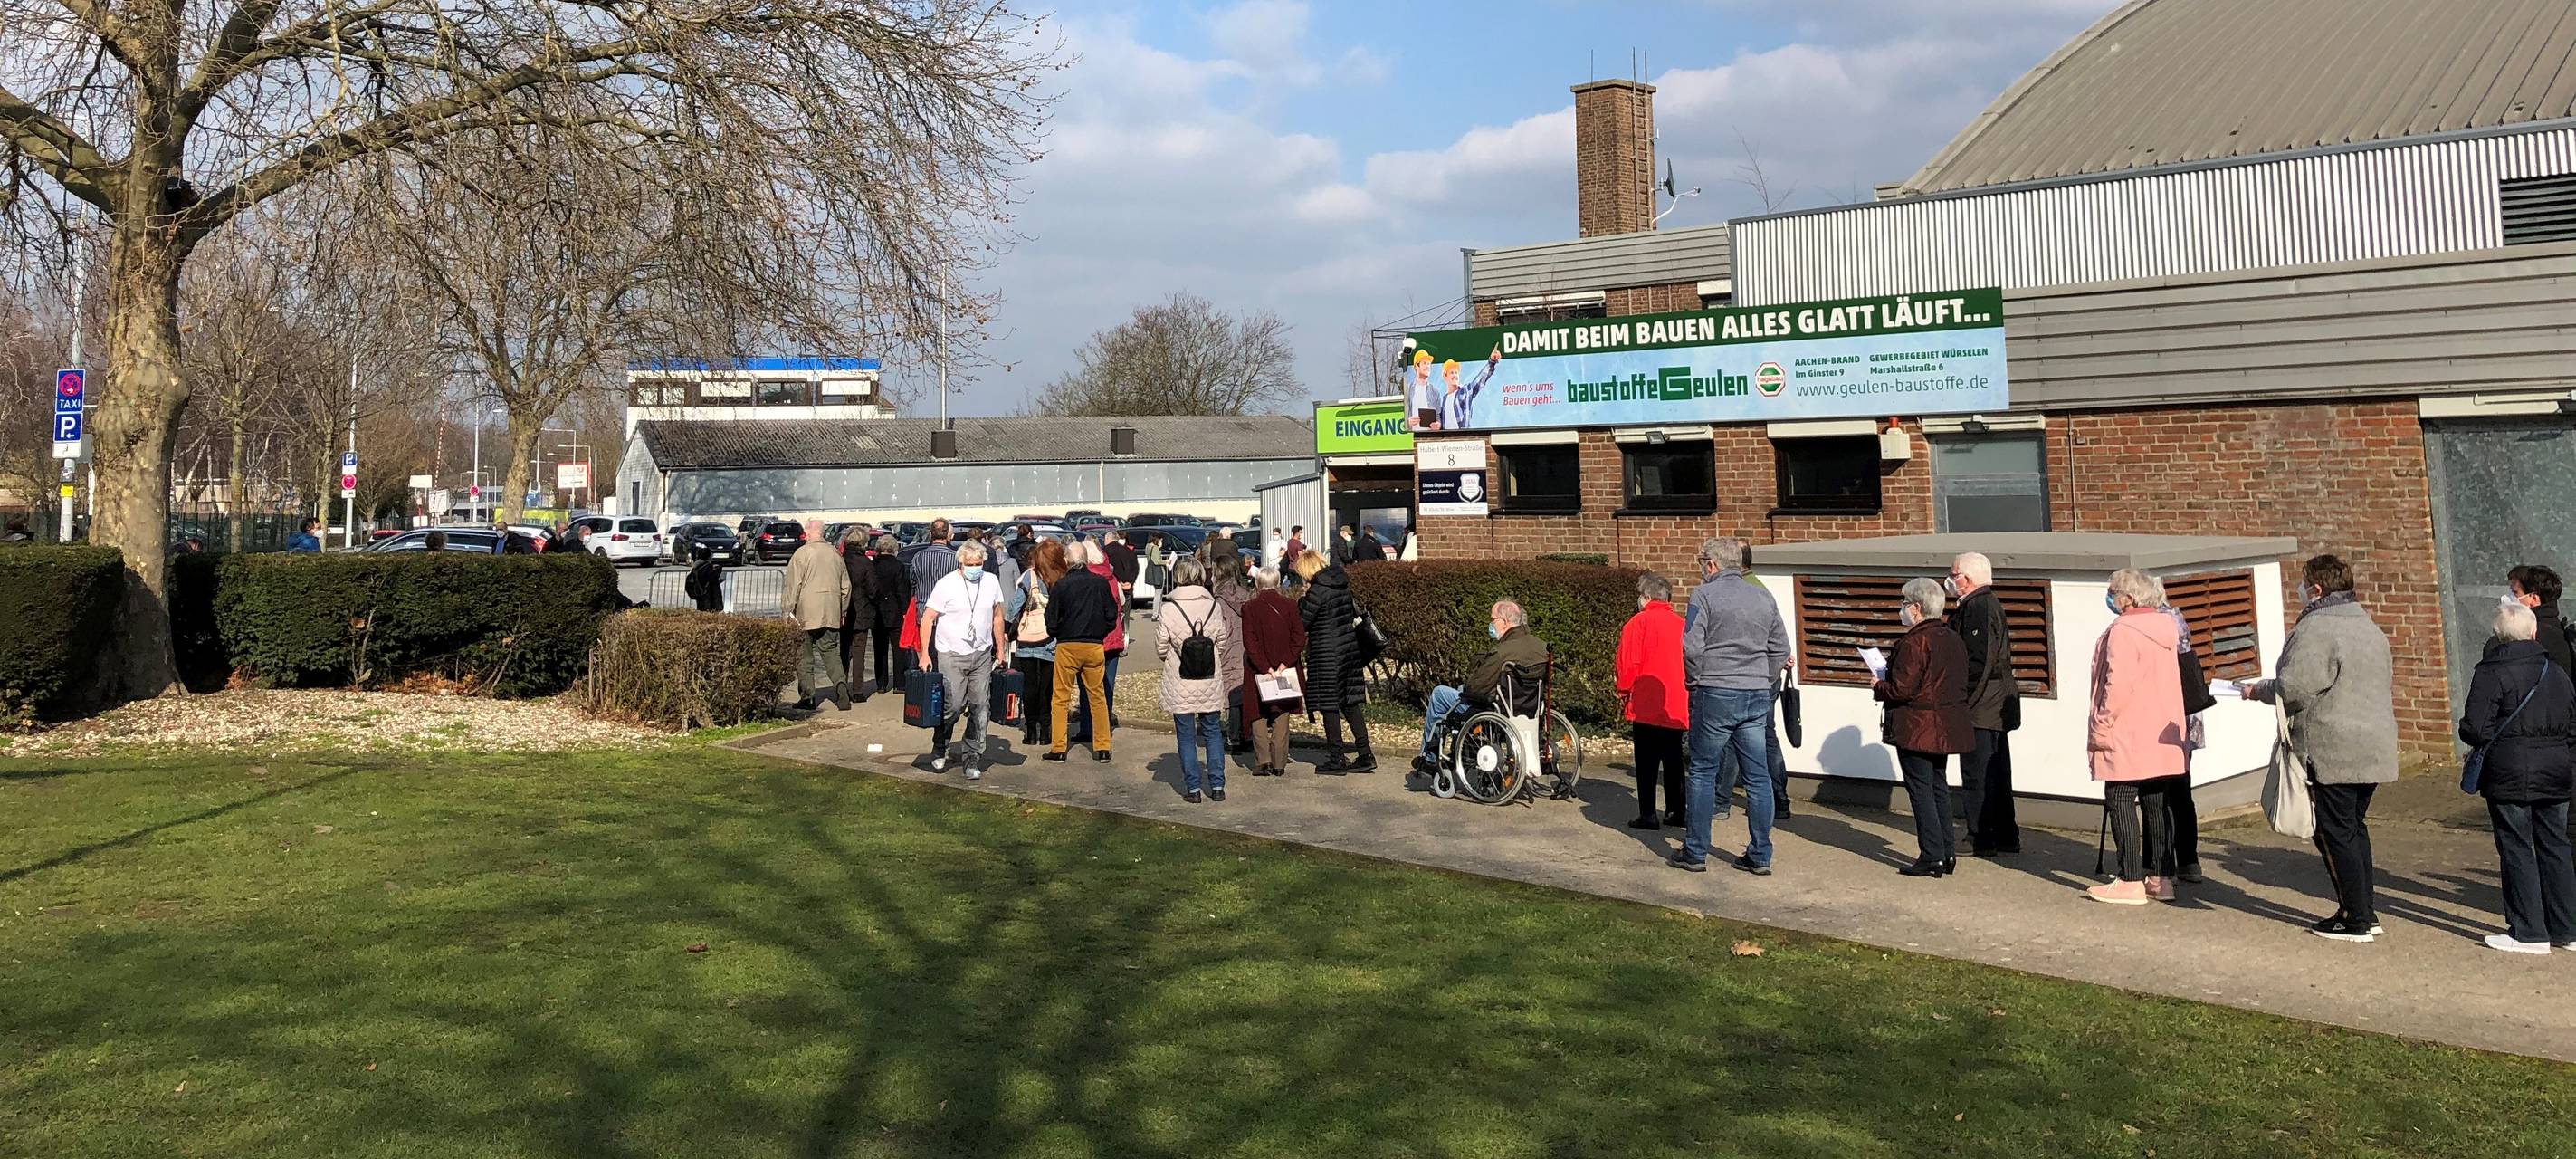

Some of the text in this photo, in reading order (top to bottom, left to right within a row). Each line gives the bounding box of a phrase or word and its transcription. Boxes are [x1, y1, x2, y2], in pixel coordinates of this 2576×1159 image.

[1503, 295, 1990, 353] DAMIT BEIM BAUEN ALLES GLATT LÄUFT...
[1795, 355, 1860, 366] AACHEN-BRAND
[1869, 348, 1989, 362] GEWERBEGEBIET WÜRSELEN
[1807, 369, 1837, 378] Ginster
[1839, 369, 1845, 377] 9
[1870, 363, 1944, 374] Marshallstraße 6
[1535, 381, 1554, 392] ums
[1797, 375, 1989, 398] www.geulen-baustoffe.de
[60, 399, 81, 408] TAXI
[1503, 394, 1561, 407] Bauen geht...
[61, 417, 76, 437] P
[345, 454, 353, 464] P
[1448, 454, 1455, 466] 8
